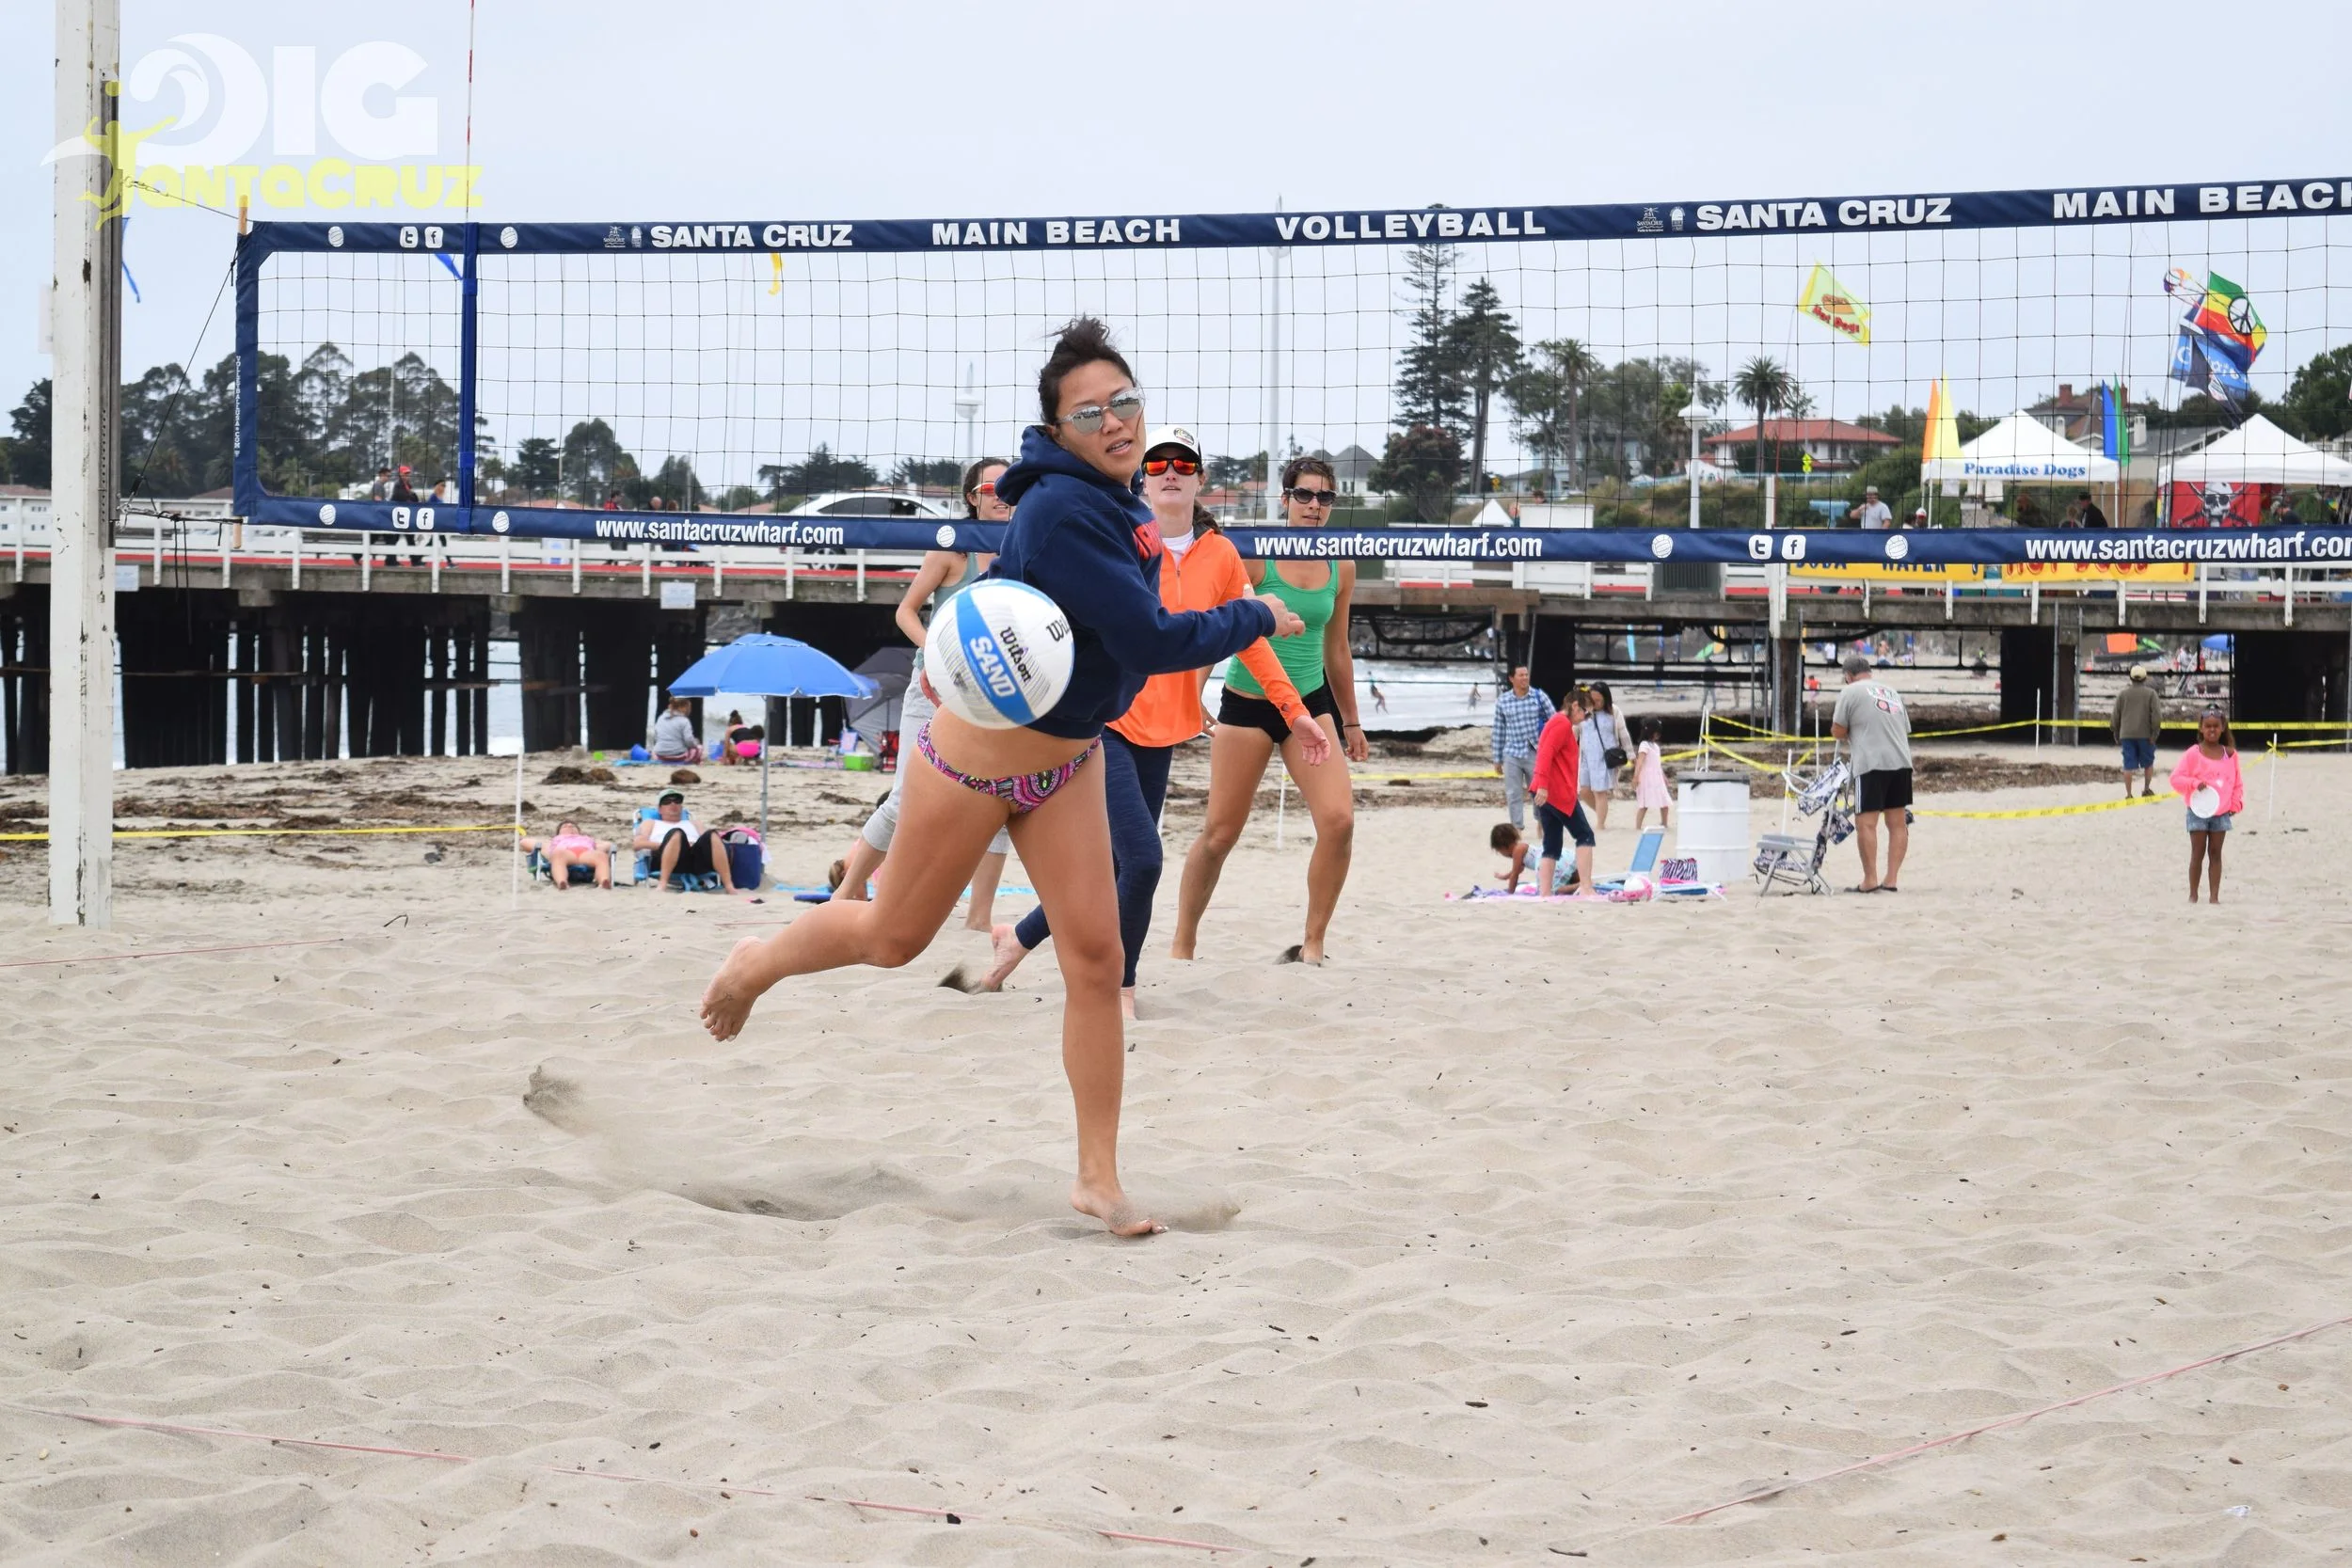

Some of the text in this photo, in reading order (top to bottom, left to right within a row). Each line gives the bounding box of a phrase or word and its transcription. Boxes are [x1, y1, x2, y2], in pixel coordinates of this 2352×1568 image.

[1696, 198, 1951, 230] SANTA CRUZ
[2053, 188, 2174, 218] MAIN
[650, 225, 755, 248] SANTA
[763, 224, 852, 246] CRUZ
[932, 218, 1180, 245] MAIN BEACH
[1275, 211, 1546, 240] VOLLEYBALL
[1963, 462, 2086, 479] Paradise Dogs
[596, 518, 844, 546] www.santacruzwharf.com
[1254, 531, 1542, 558] www.santacruzwharf.com
[970, 636, 1016, 698] SAND
[999, 626, 1032, 683] Wilson
